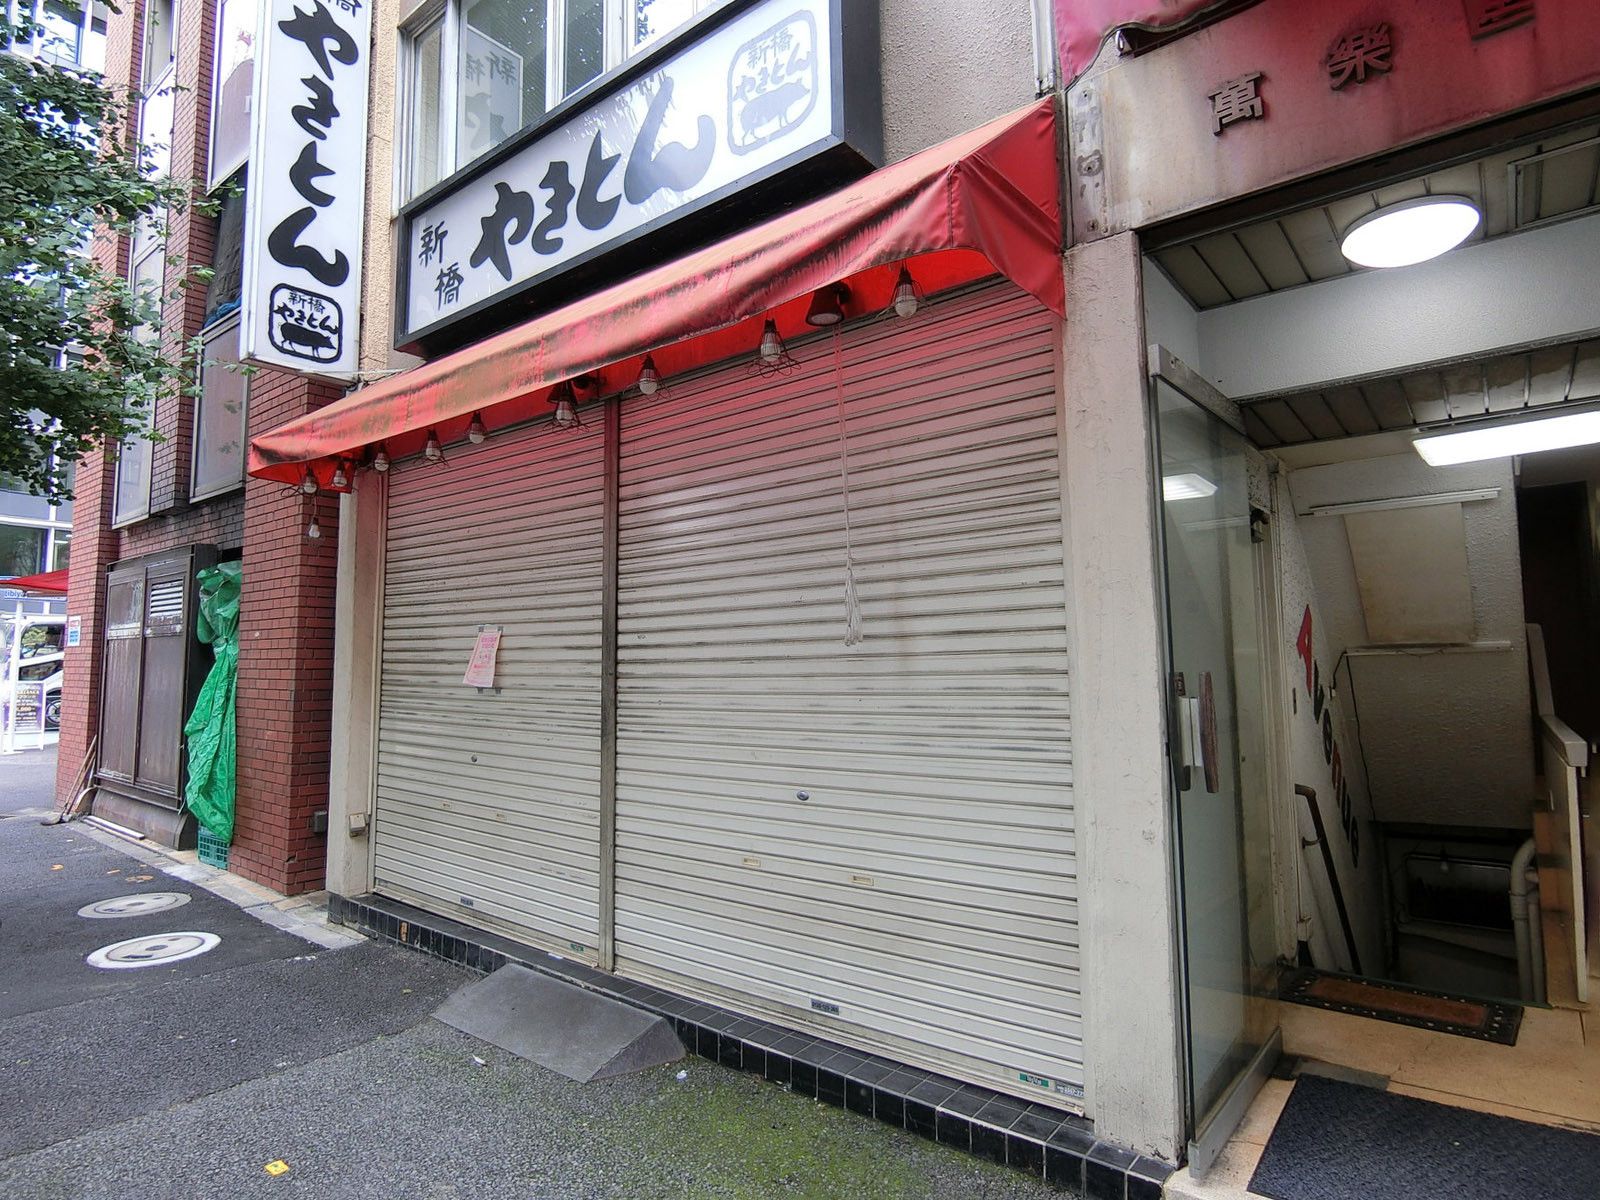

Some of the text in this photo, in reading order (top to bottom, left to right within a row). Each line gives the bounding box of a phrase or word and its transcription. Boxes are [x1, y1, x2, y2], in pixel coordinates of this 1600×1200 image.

[732, 42, 811, 102] やきとん
[747, 27, 793, 69] 新橋
[268, 0, 359, 287] やきとん
[470, 75, 716, 281] やきとん
[418, 220, 464, 311] 新橋
[273, 302, 339, 335] やきとん
[288, 291, 326, 314] 新橋
